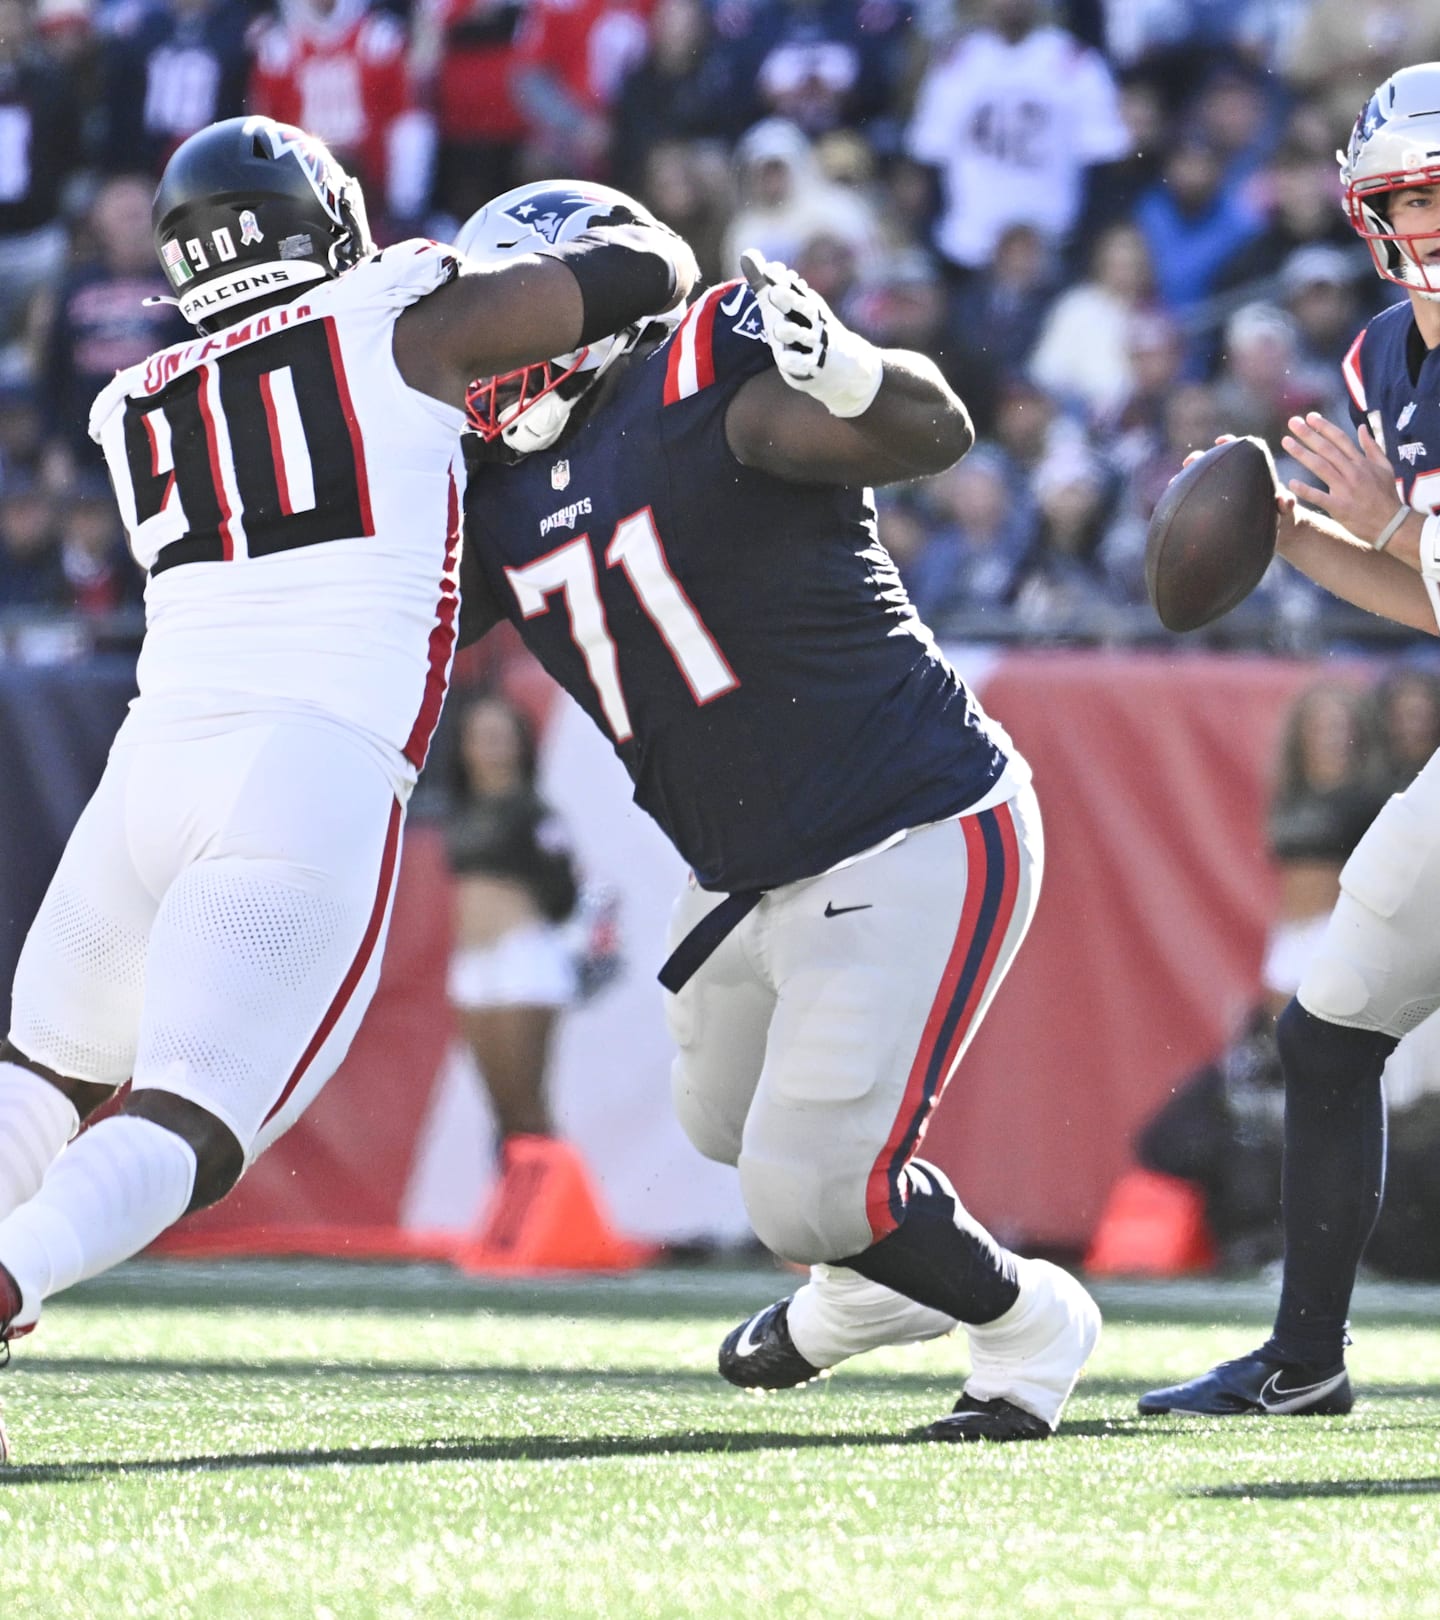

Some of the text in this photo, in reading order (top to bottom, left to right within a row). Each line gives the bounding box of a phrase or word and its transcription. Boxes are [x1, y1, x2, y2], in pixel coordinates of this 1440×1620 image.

[185, 226, 237, 272] 90
[183, 270, 290, 317] FALCONS
[122, 314, 376, 580] 90
[539, 496, 593, 537] PATRIOTS
[502, 504, 742, 744] 71
